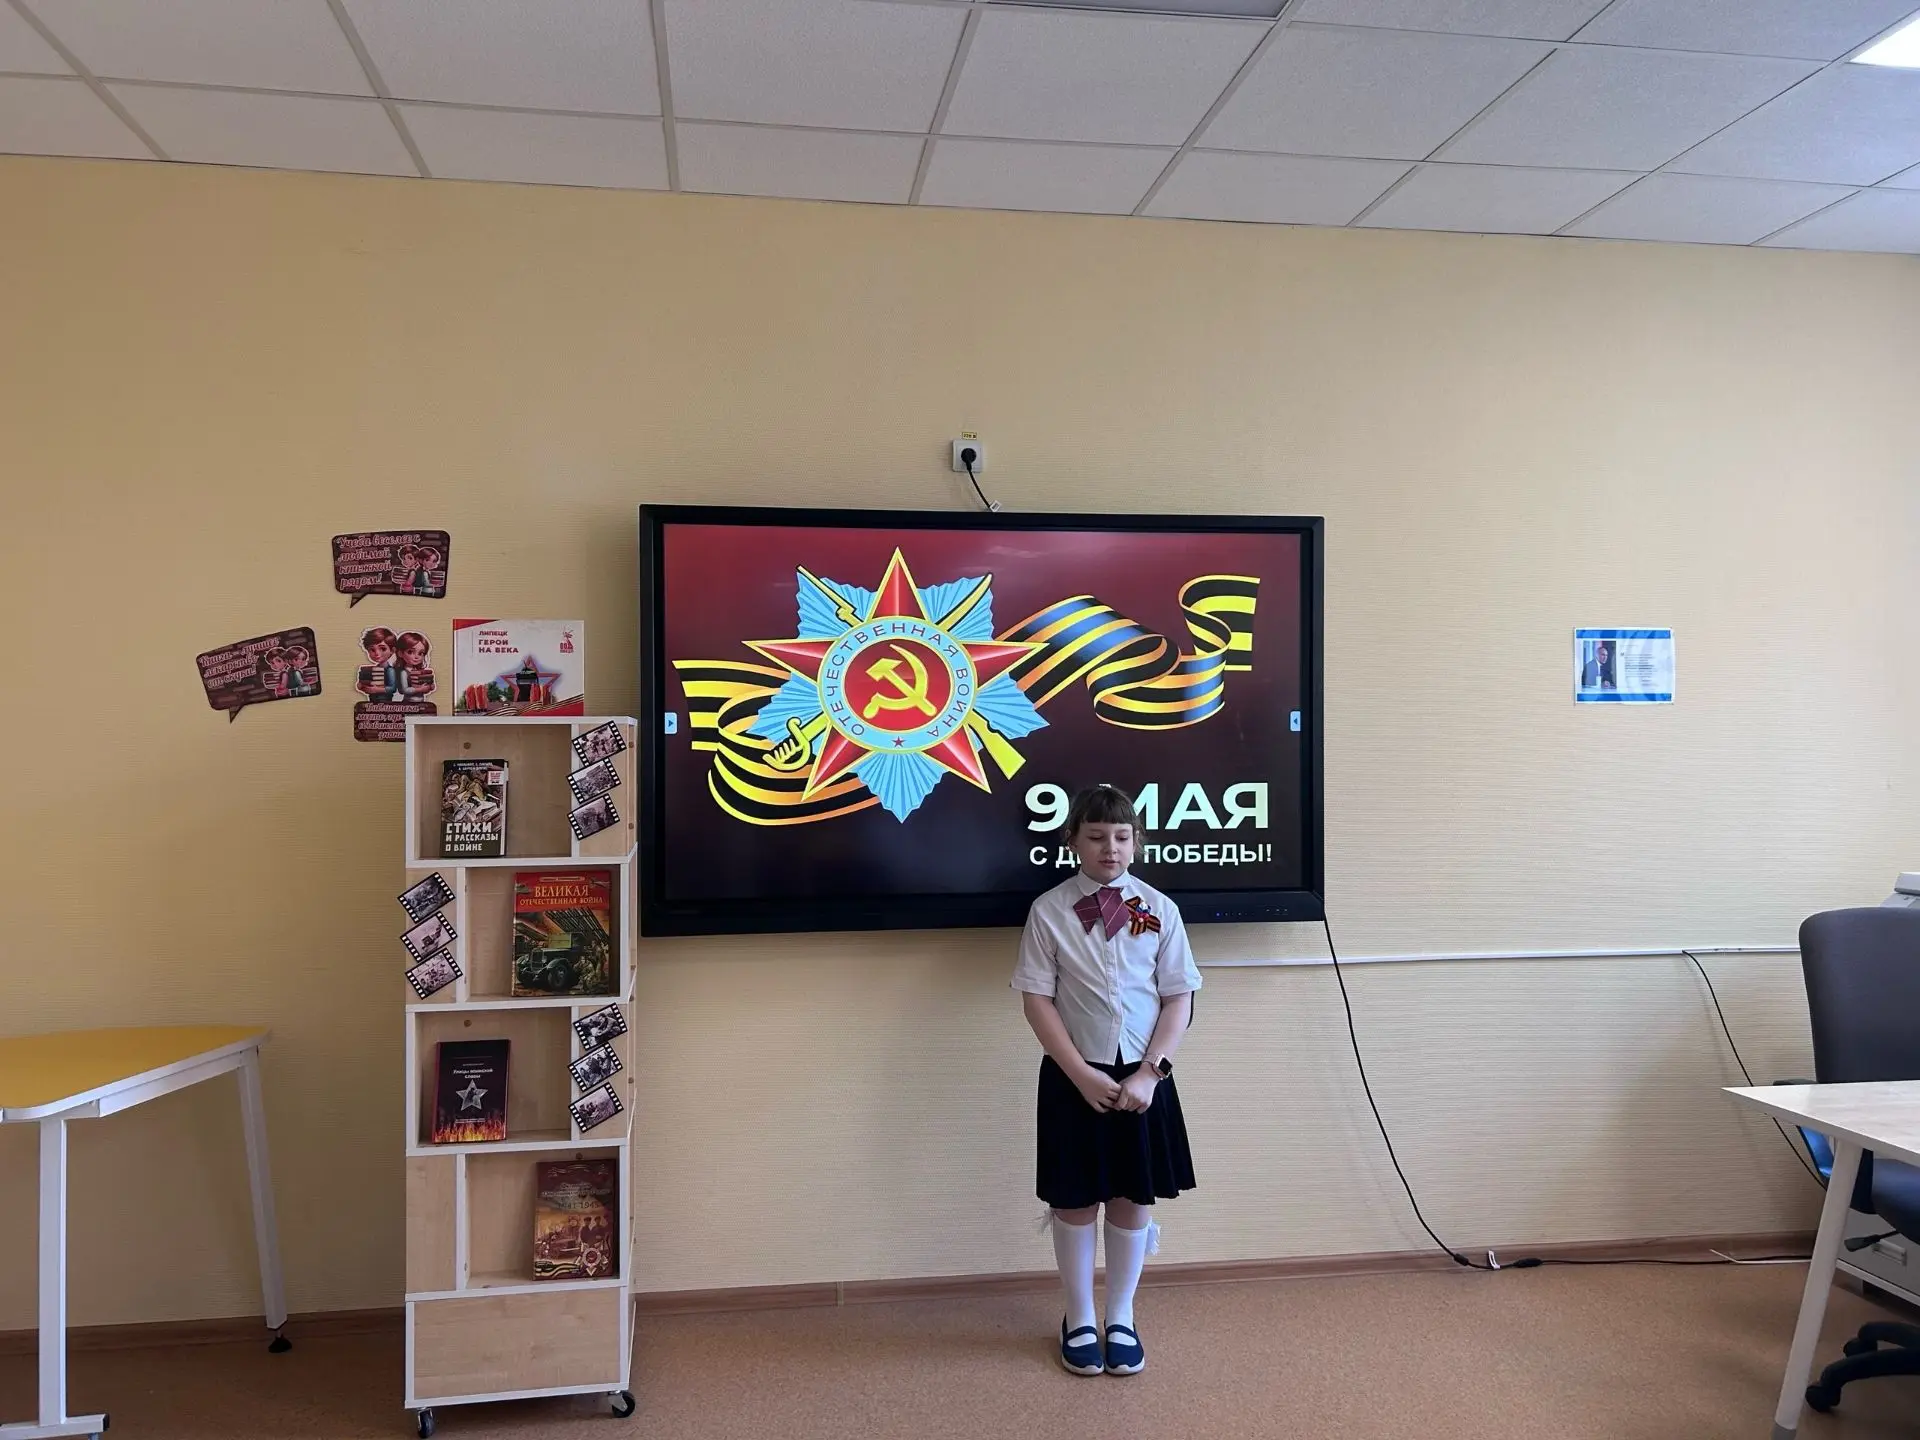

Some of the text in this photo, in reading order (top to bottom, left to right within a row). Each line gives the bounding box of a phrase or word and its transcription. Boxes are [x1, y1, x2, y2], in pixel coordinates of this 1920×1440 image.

[374, 534, 414, 546] веселее
[338, 547, 392, 561] любимой
[339, 560, 392, 574] книжкой
[340, 573, 382, 590] рядом!
[200, 652, 232, 667] Книга
[203, 653, 259, 678] лекарство
[207, 663, 257, 689] от скуки!
[826, 623, 970, 737] ОТЕЧЕСТВЕННАЯ ВОЙНА
[1024, 783, 1070, 832] 9
[446, 822, 492, 833] СТИХИ
[455, 833, 498, 841] РАССКАЗЫ
[454, 841, 482, 851] ВОЙНЕ
[1029, 846, 1047, 864] С
[1143, 844, 1272, 866] ПОБЕДЫ!
[534, 884, 589, 897] ВЕЛИКАЯ
[580, 896, 603, 904] ВОЙНА
